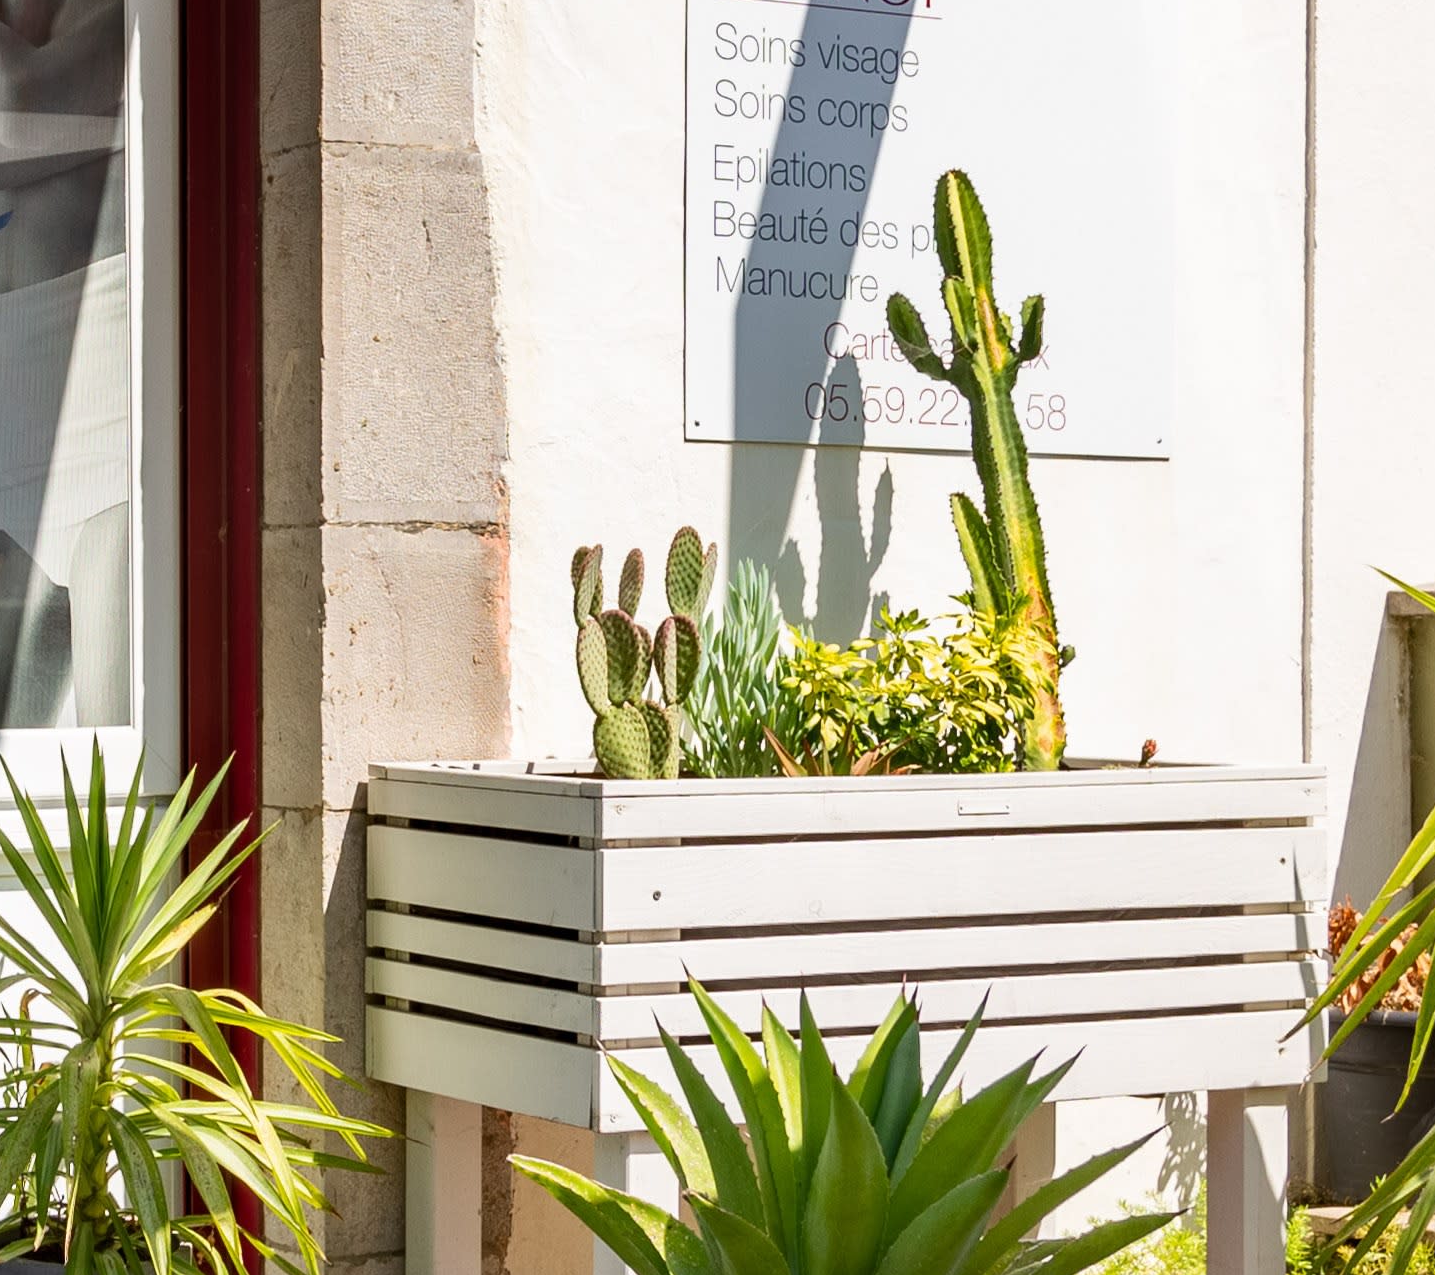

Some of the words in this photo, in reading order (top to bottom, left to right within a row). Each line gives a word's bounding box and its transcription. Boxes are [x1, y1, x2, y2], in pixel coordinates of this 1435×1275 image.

[714, 22, 806, 68] Soins
[817, 34, 920, 84] visage
[714, 79, 806, 124] Soins
[817, 97, 909, 138] corps
[714, 144, 867, 193] Epilations
[713, 201, 829, 246] Beauté
[839, 212, 899, 251] des
[716, 256, 879, 302] Manucure
[805, 382, 1067, 431] 05.59.22.58
